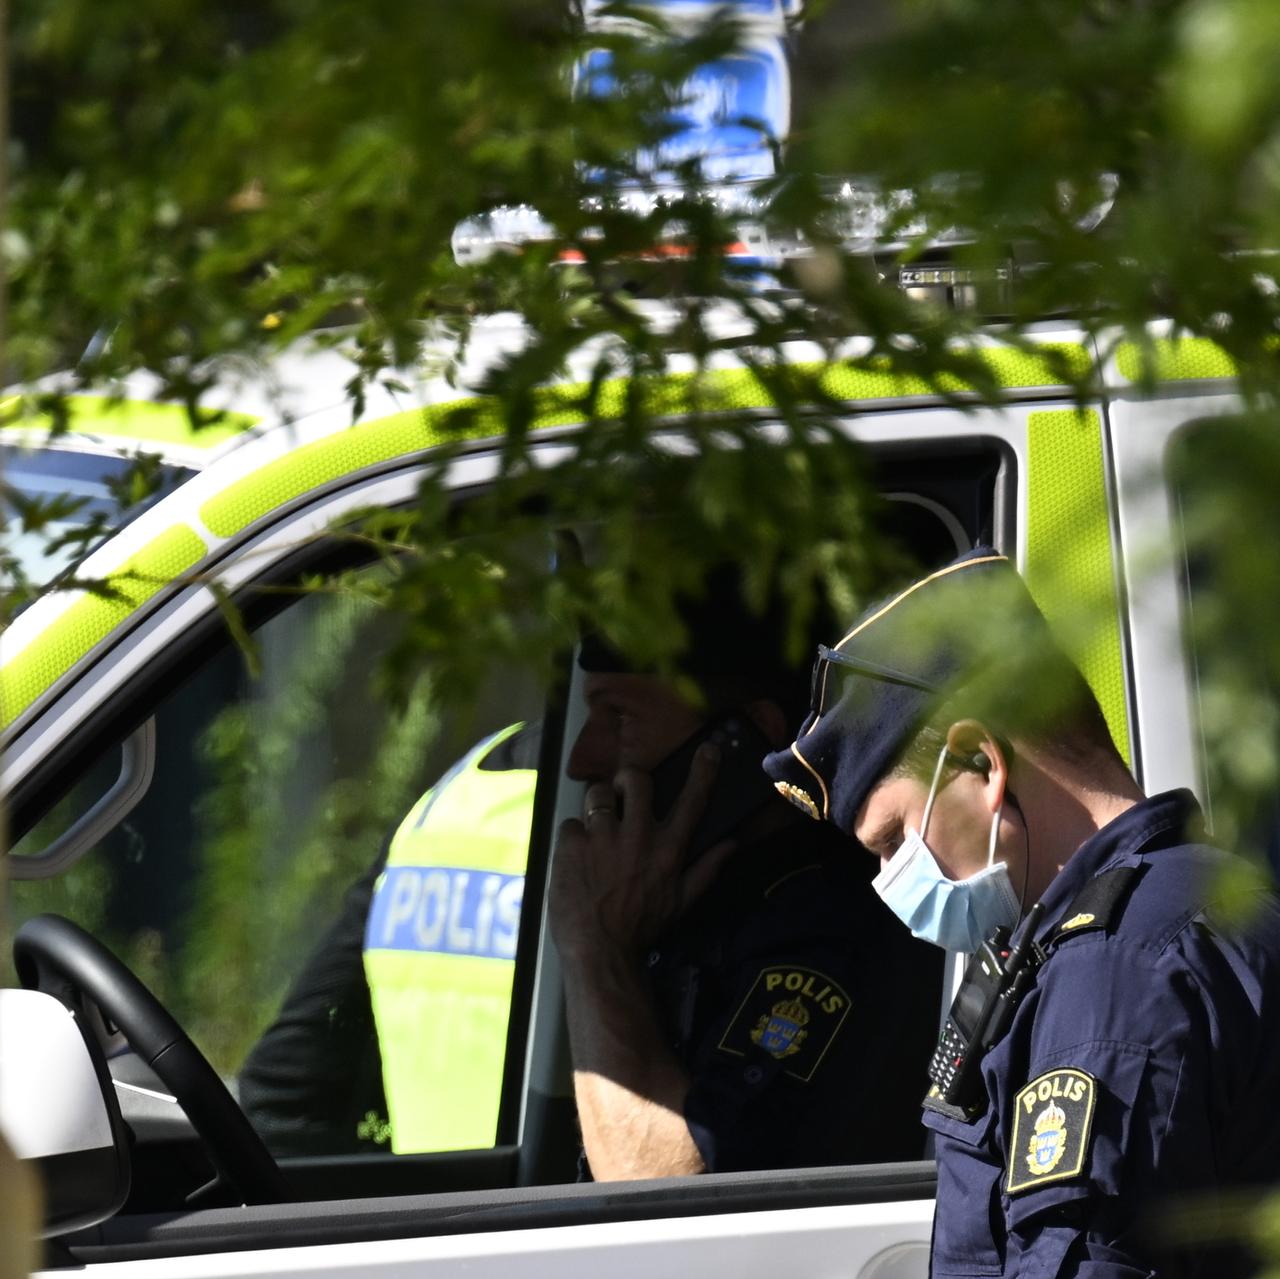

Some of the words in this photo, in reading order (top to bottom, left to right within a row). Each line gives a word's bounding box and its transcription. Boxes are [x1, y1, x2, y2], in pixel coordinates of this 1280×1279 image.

[383, 870, 525, 953] POLIS
[765, 972, 844, 1013] POLIS
[1022, 1077, 1087, 1114] POLIS
